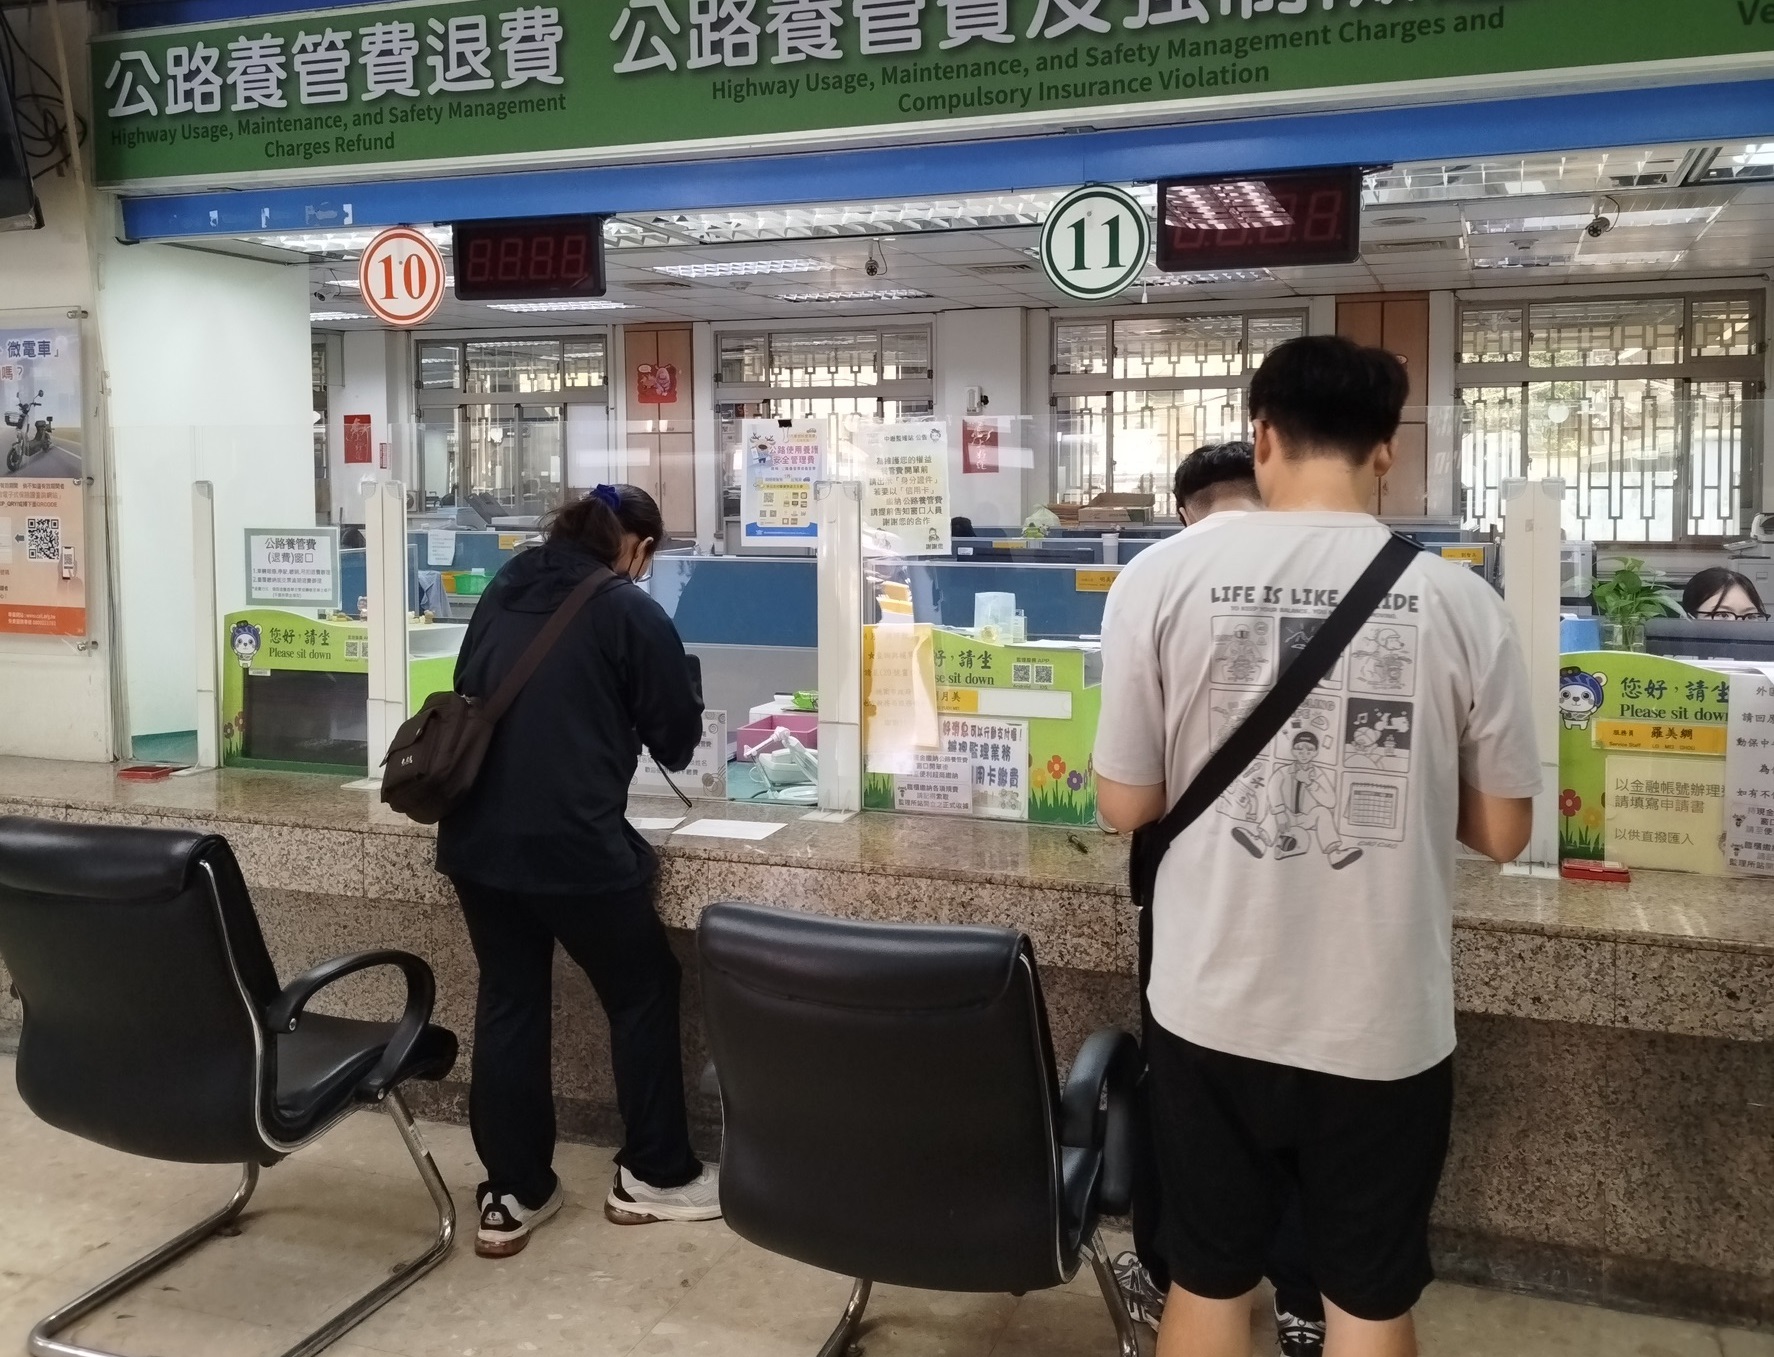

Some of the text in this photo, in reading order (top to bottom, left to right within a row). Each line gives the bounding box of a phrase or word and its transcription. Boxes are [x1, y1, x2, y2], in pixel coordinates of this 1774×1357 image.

[105, 6, 565, 118] 公路養管費退費
[711, 9, 1504, 103] Highway Usage, Maintenance, and Safety Management Charges and
[898, 63, 1269, 113] Compulsory Insurance Violation
[111, 93, 566, 148] Highway Usage, Maintenance, and Safety Management
[264, 131, 395, 160] Charges Refund
[1067, 214, 1126, 272] 11
[378, 253, 427, 300] 10
[264, 538, 316, 551] 公路養管費
[1211, 586, 1419, 613] LIFE IS LIKE IDE
[269, 648, 331, 660] Please sit down
[934, 649, 993, 670] 好，請坐
[948, 672, 962, 684] sit
[965, 673, 994, 686] down
[936, 690, 961, 702] 月美
[1620, 704, 1666, 719] Please
[1671, 705, 1690, 720] sit
[943, 720, 969, 738] 好消息
[1736, 737, 1774, 748] 動保中
[972, 765, 1019, 789] 用卡繳費
[1736, 788, 1774, 799] 如有不
[1614, 795, 1704, 813] 請填寫申請書
[1614, 828, 1694, 846] 以供直撥匯入
